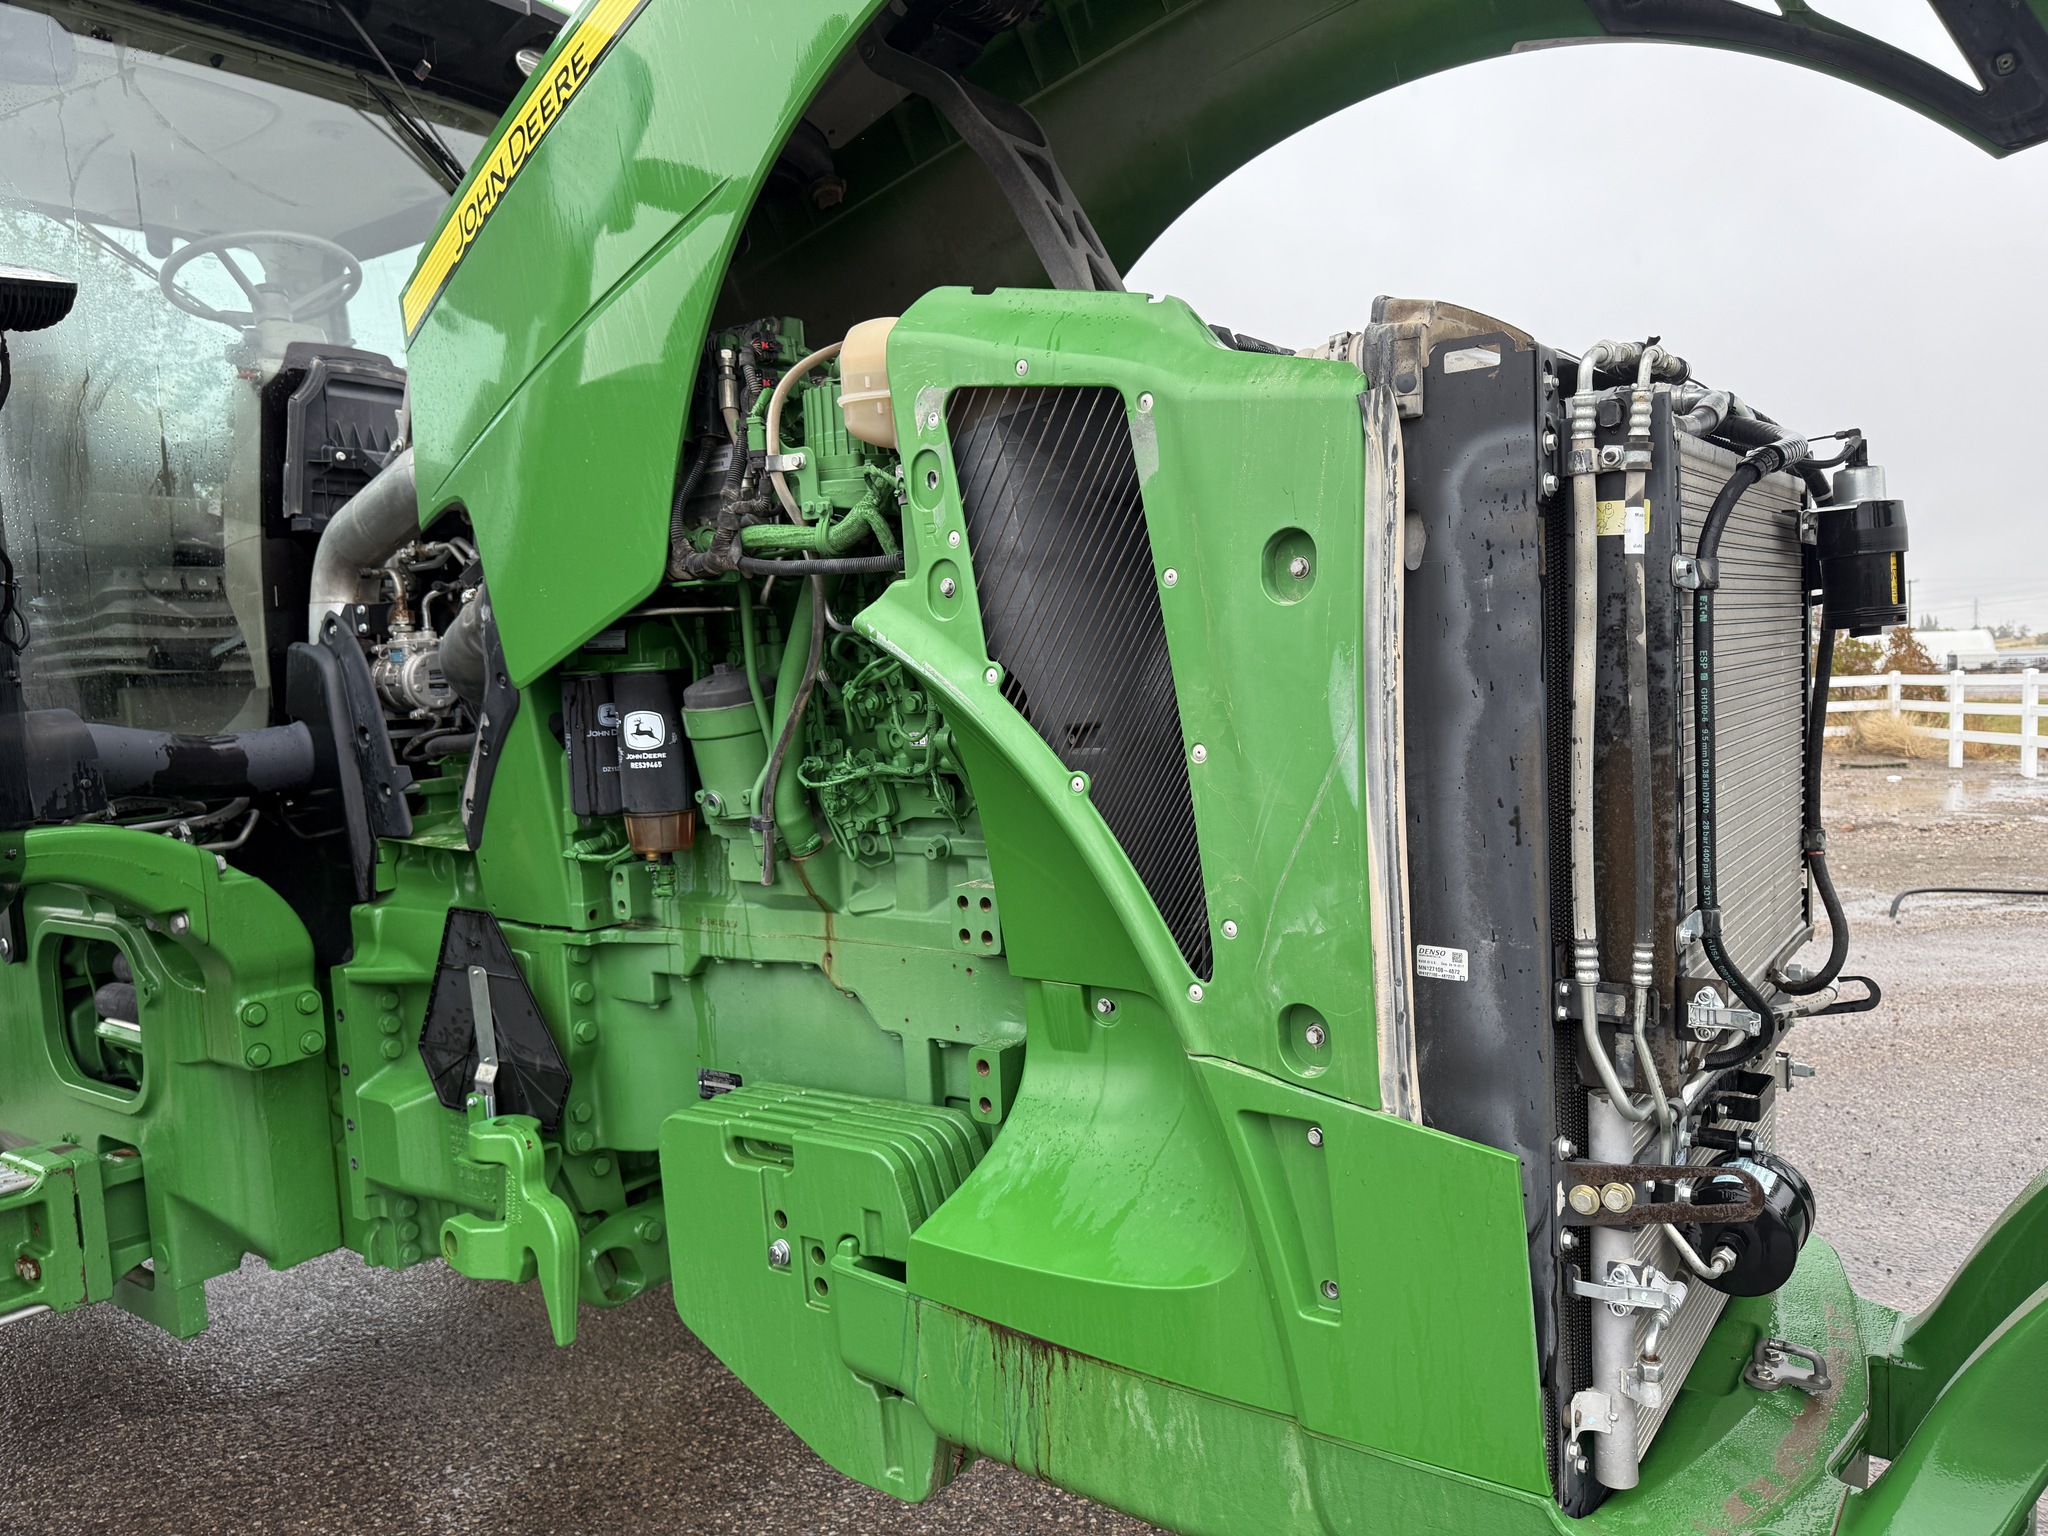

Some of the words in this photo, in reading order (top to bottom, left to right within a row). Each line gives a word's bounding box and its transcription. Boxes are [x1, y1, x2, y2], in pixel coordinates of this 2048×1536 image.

[456, 156, 507, 254] JOHN
[507, 41, 590, 166] DEERE
[1699, 650, 1708, 669] ESP
[1700, 688, 1709, 722] GH100-6
[586, 729, 610, 738] JOHN
[1701, 729, 1709, 742] 9.5
[642, 752, 667, 760] DEERE
[1701, 743, 1708, 758] mm
[630, 761, 663, 769] RE539465
[1702, 792, 1710, 814] DN10
[1702, 820, 1709, 830] 28
[1702, 831, 1710, 844] bar
[1702, 845, 1711, 862] (400
[1418, 948, 1446, 957] DENSO
[1709, 945, 1720, 961] USA
